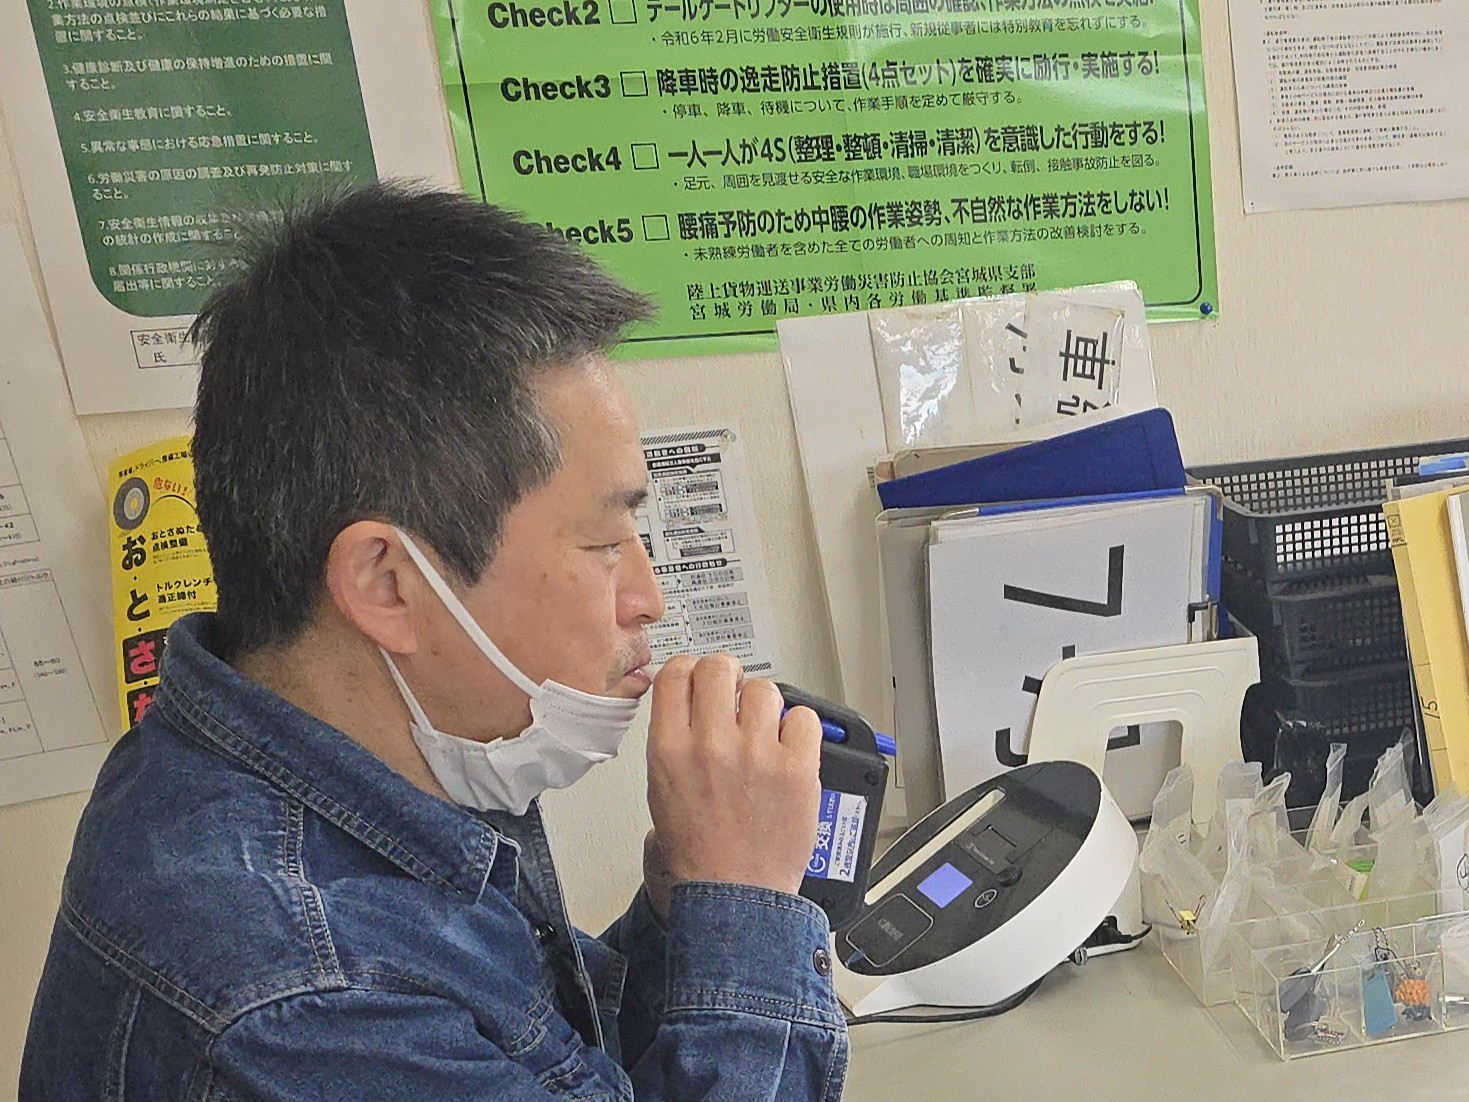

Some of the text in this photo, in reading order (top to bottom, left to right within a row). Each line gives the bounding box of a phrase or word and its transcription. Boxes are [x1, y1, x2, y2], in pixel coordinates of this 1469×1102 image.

[487, 0, 600, 28] Check2
[500, 74, 611, 102] Check3
[512, 145, 622, 176] Check4
[546, 218, 634, 245] heck5
